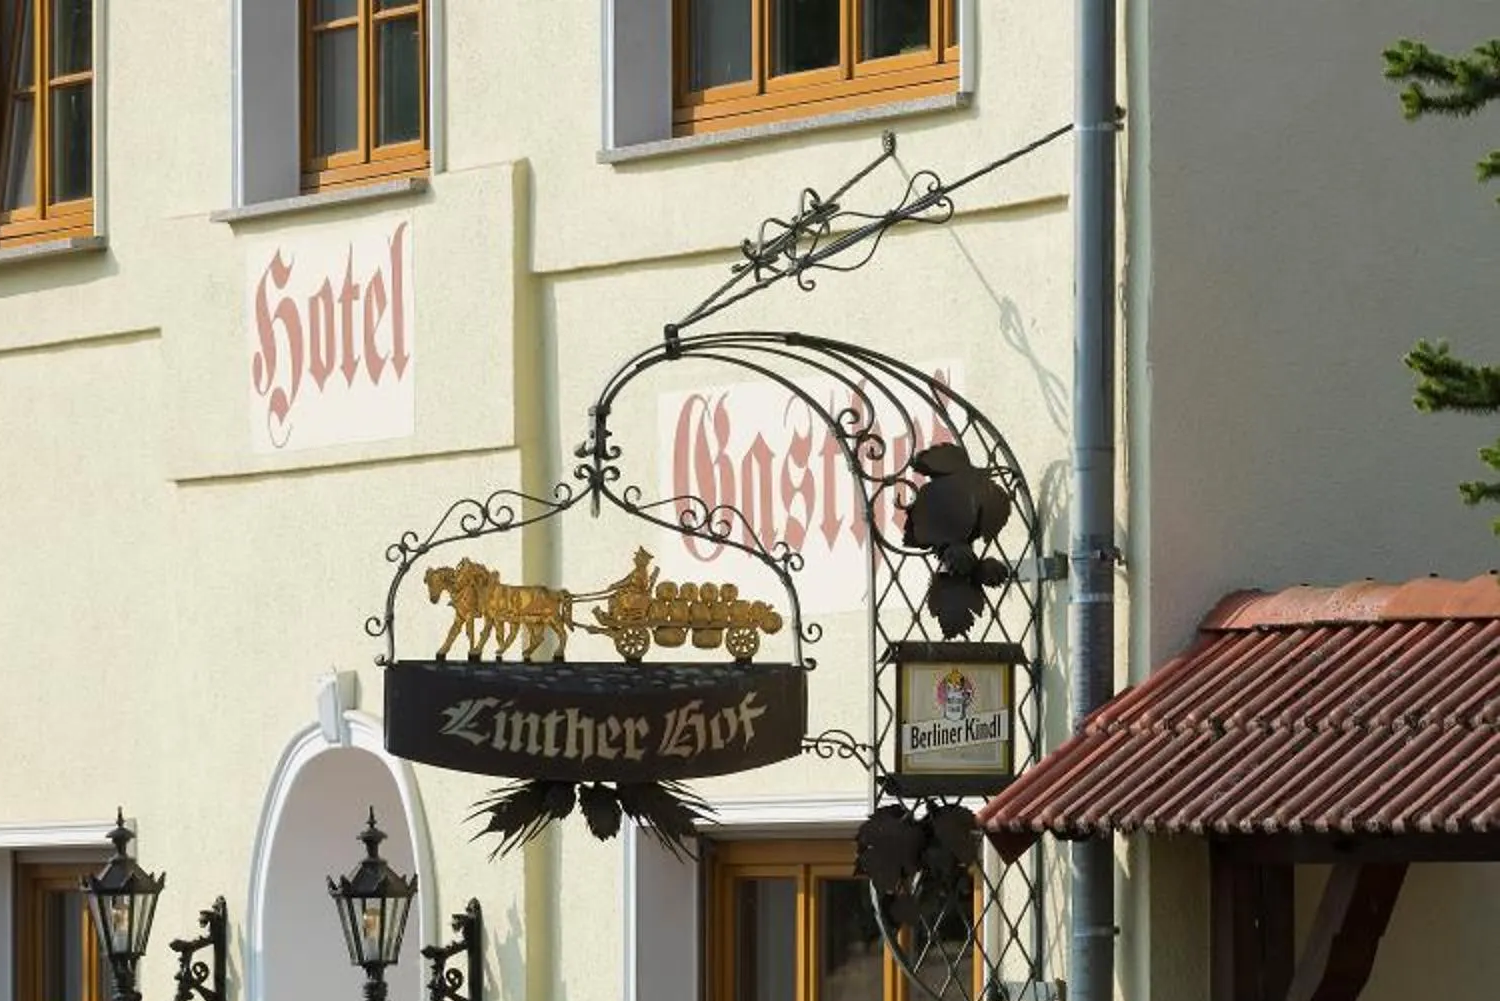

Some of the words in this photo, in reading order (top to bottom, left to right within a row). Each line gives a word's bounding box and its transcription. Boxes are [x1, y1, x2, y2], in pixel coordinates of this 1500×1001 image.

[252, 220, 411, 449] Hotel
[438, 695, 650, 764] Linther
[656, 690, 769, 761] Hof
[911, 722, 962, 750] Berliner
[965, 713, 1001, 742] Kindl
